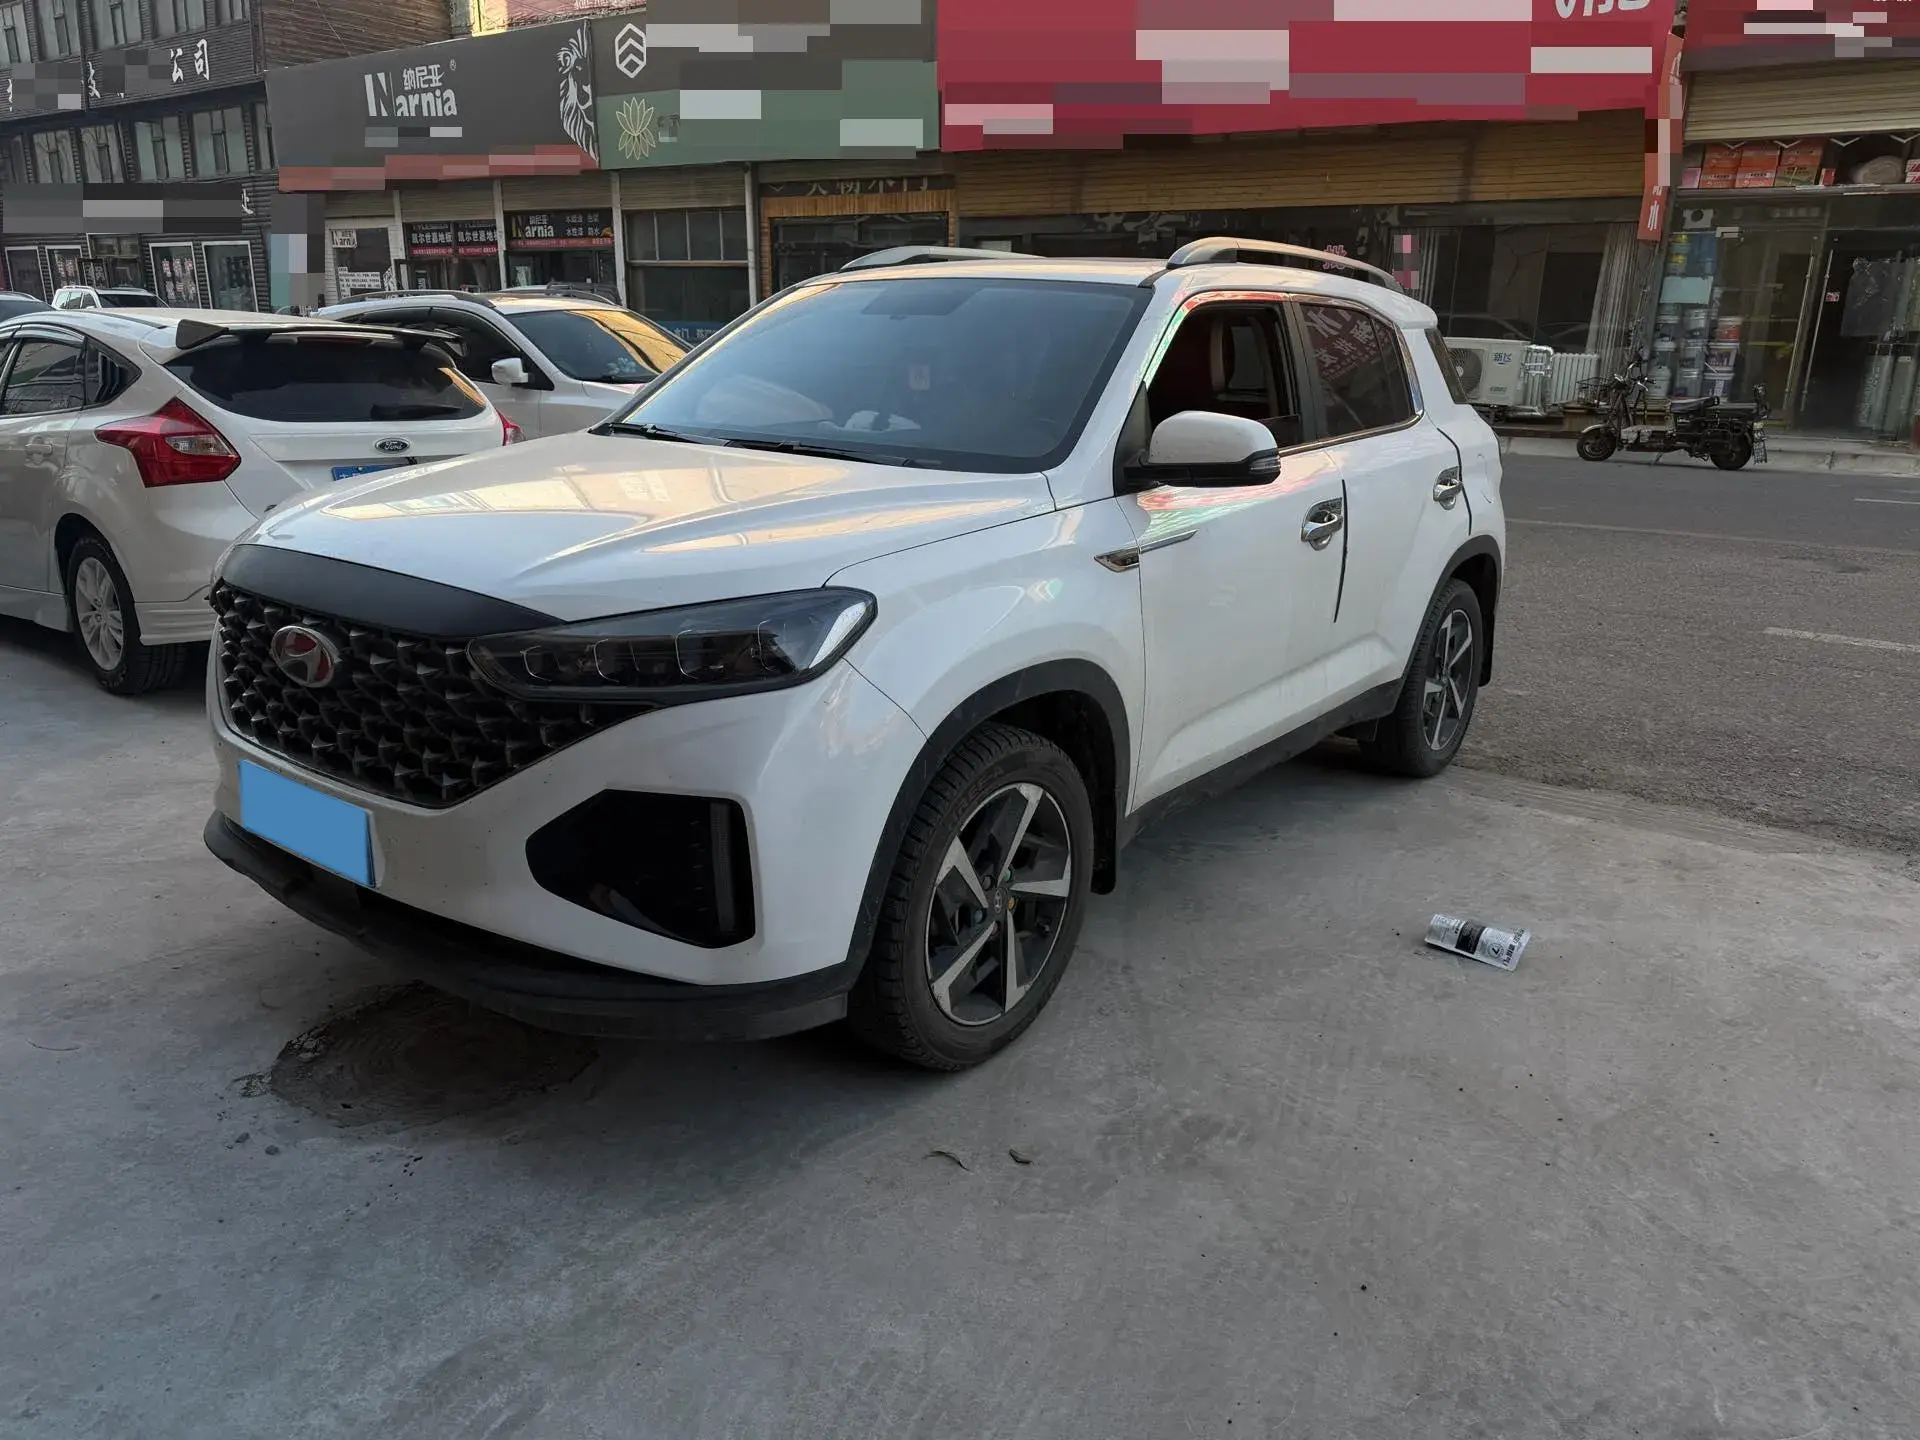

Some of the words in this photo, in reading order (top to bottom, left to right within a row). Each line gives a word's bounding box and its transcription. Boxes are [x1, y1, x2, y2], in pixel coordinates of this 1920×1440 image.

[170, 38, 210, 83] 公司
[402, 64, 445, 90] 纳尼亚
[364, 72, 458, 117] Narnia
